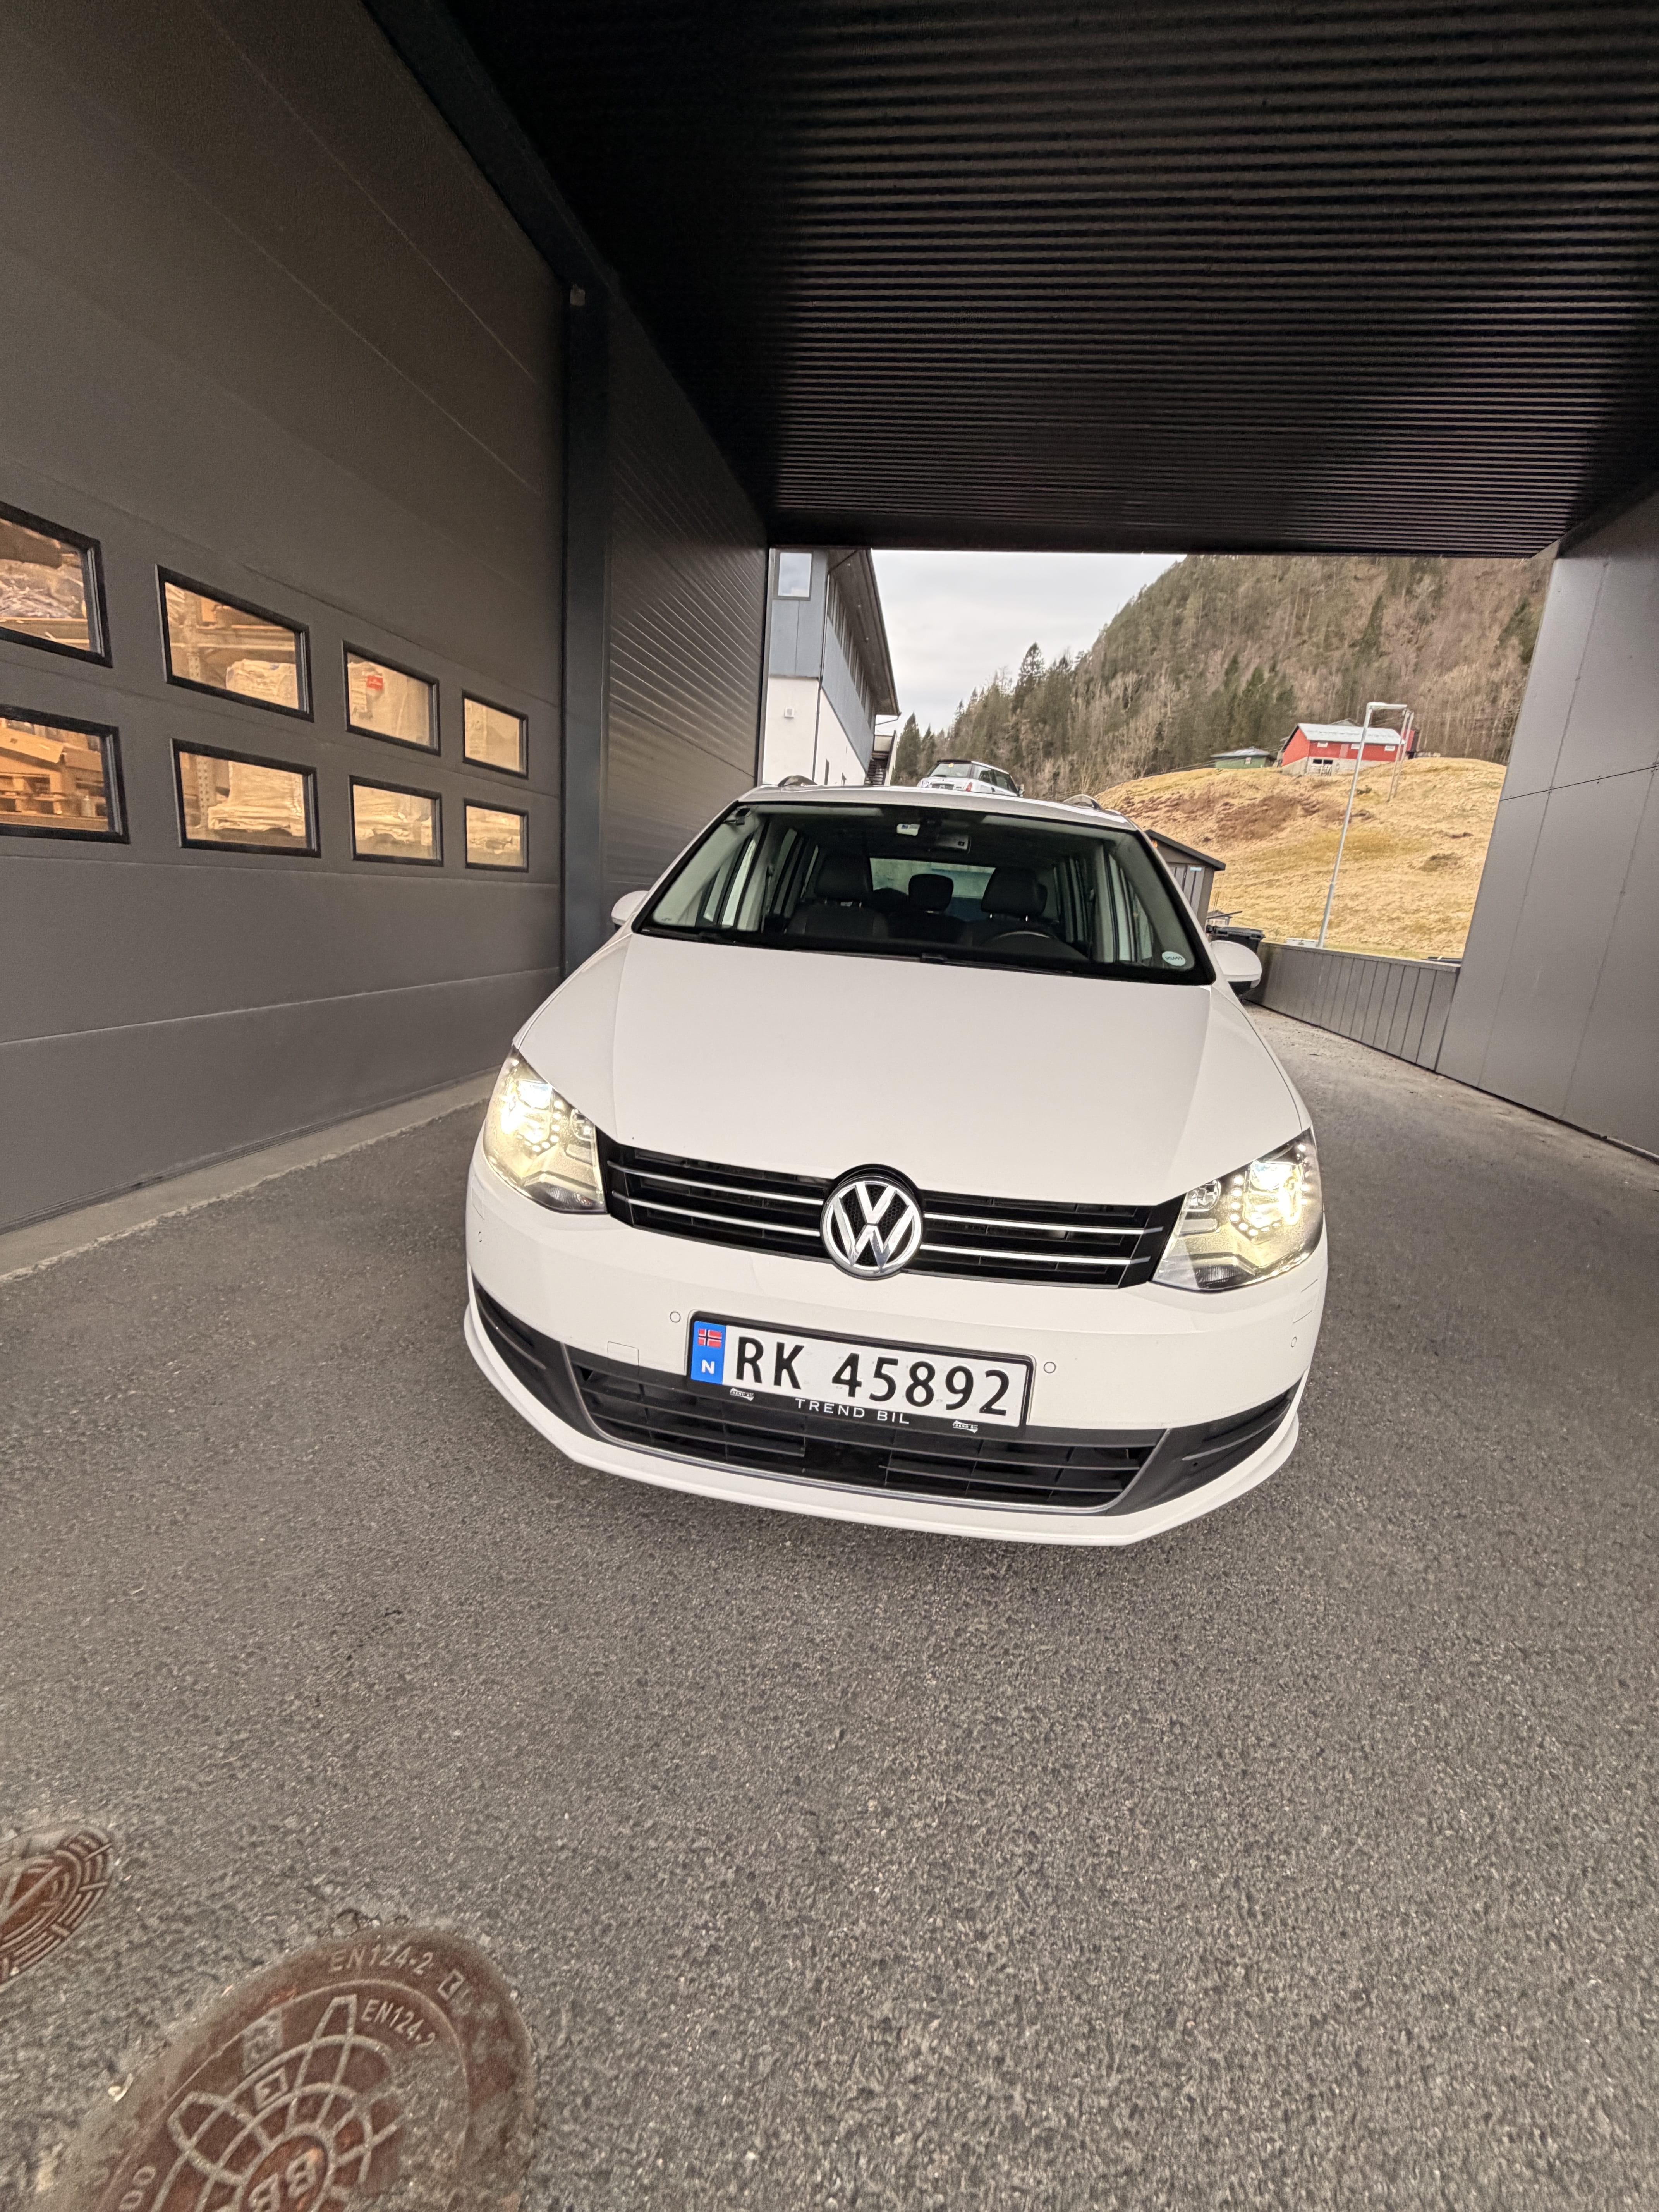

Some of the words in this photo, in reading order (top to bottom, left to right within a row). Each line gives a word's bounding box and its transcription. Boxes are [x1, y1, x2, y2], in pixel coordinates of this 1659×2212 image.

[701, 1360, 715, 1374] N
[736, 1336, 804, 1389] RK
[831, 1352, 1010, 1416] 45892
[795, 1398, 865, 1418] TREND
[877, 1410, 910, 1425] BIL
